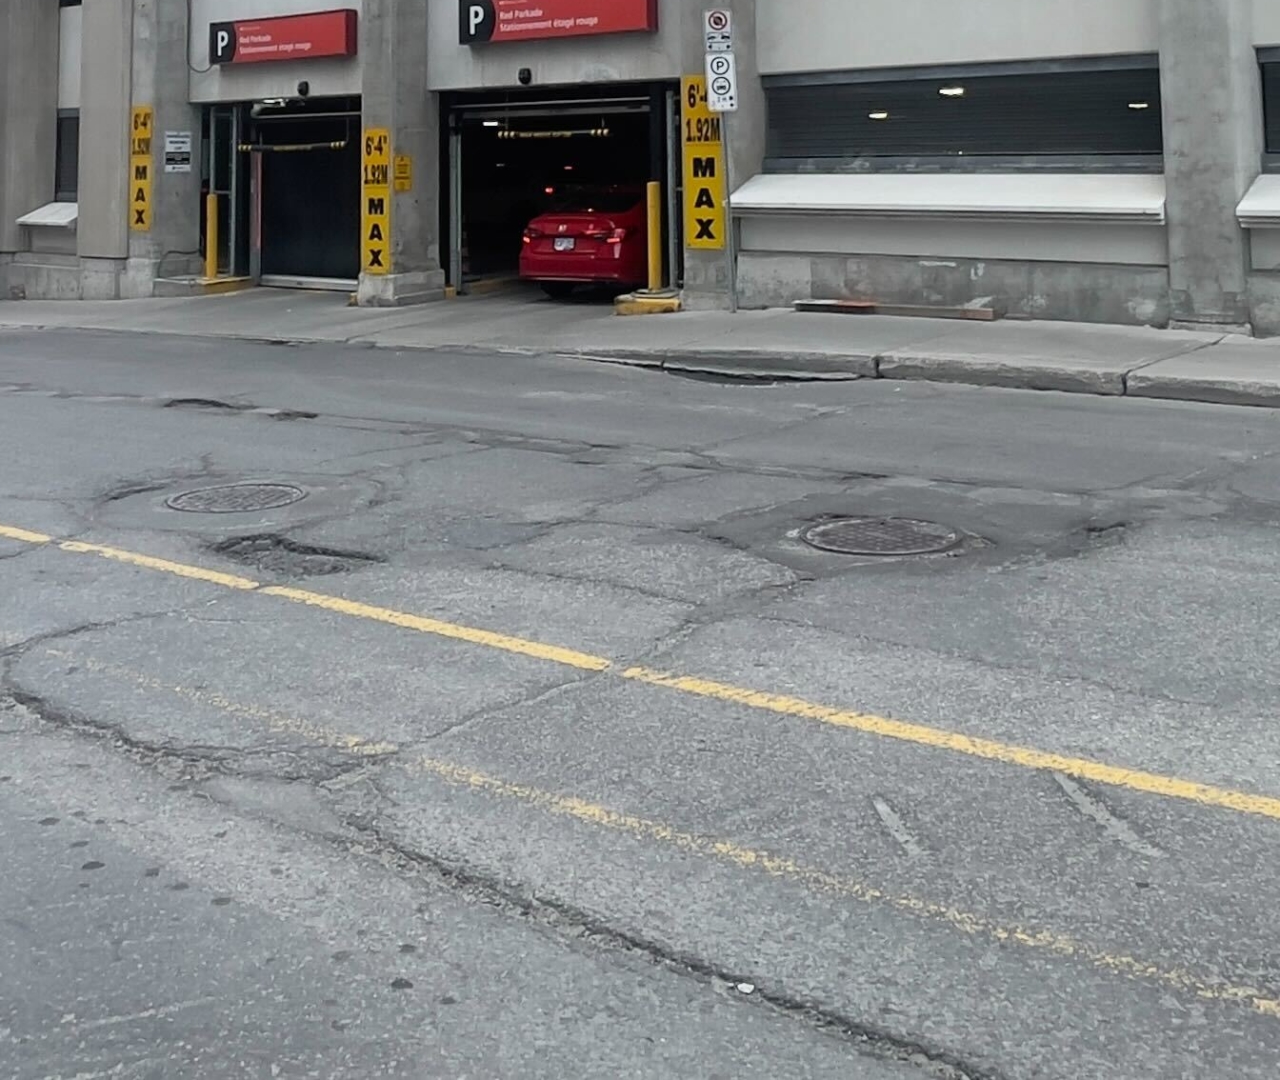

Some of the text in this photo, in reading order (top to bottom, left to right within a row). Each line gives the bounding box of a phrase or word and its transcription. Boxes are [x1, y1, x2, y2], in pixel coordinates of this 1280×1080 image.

[469, 6, 484, 36] P
[515, 8, 543, 19] Parkade
[218, 31, 228, 56] P
[716, 61, 724, 71] P
[686, 118, 720, 142] 1.92M
[364, 165, 388, 185] 1.92M
[134, 165, 148, 225] MAX
[693, 157, 715, 239] MAX
[368, 197, 384, 267] MAX
